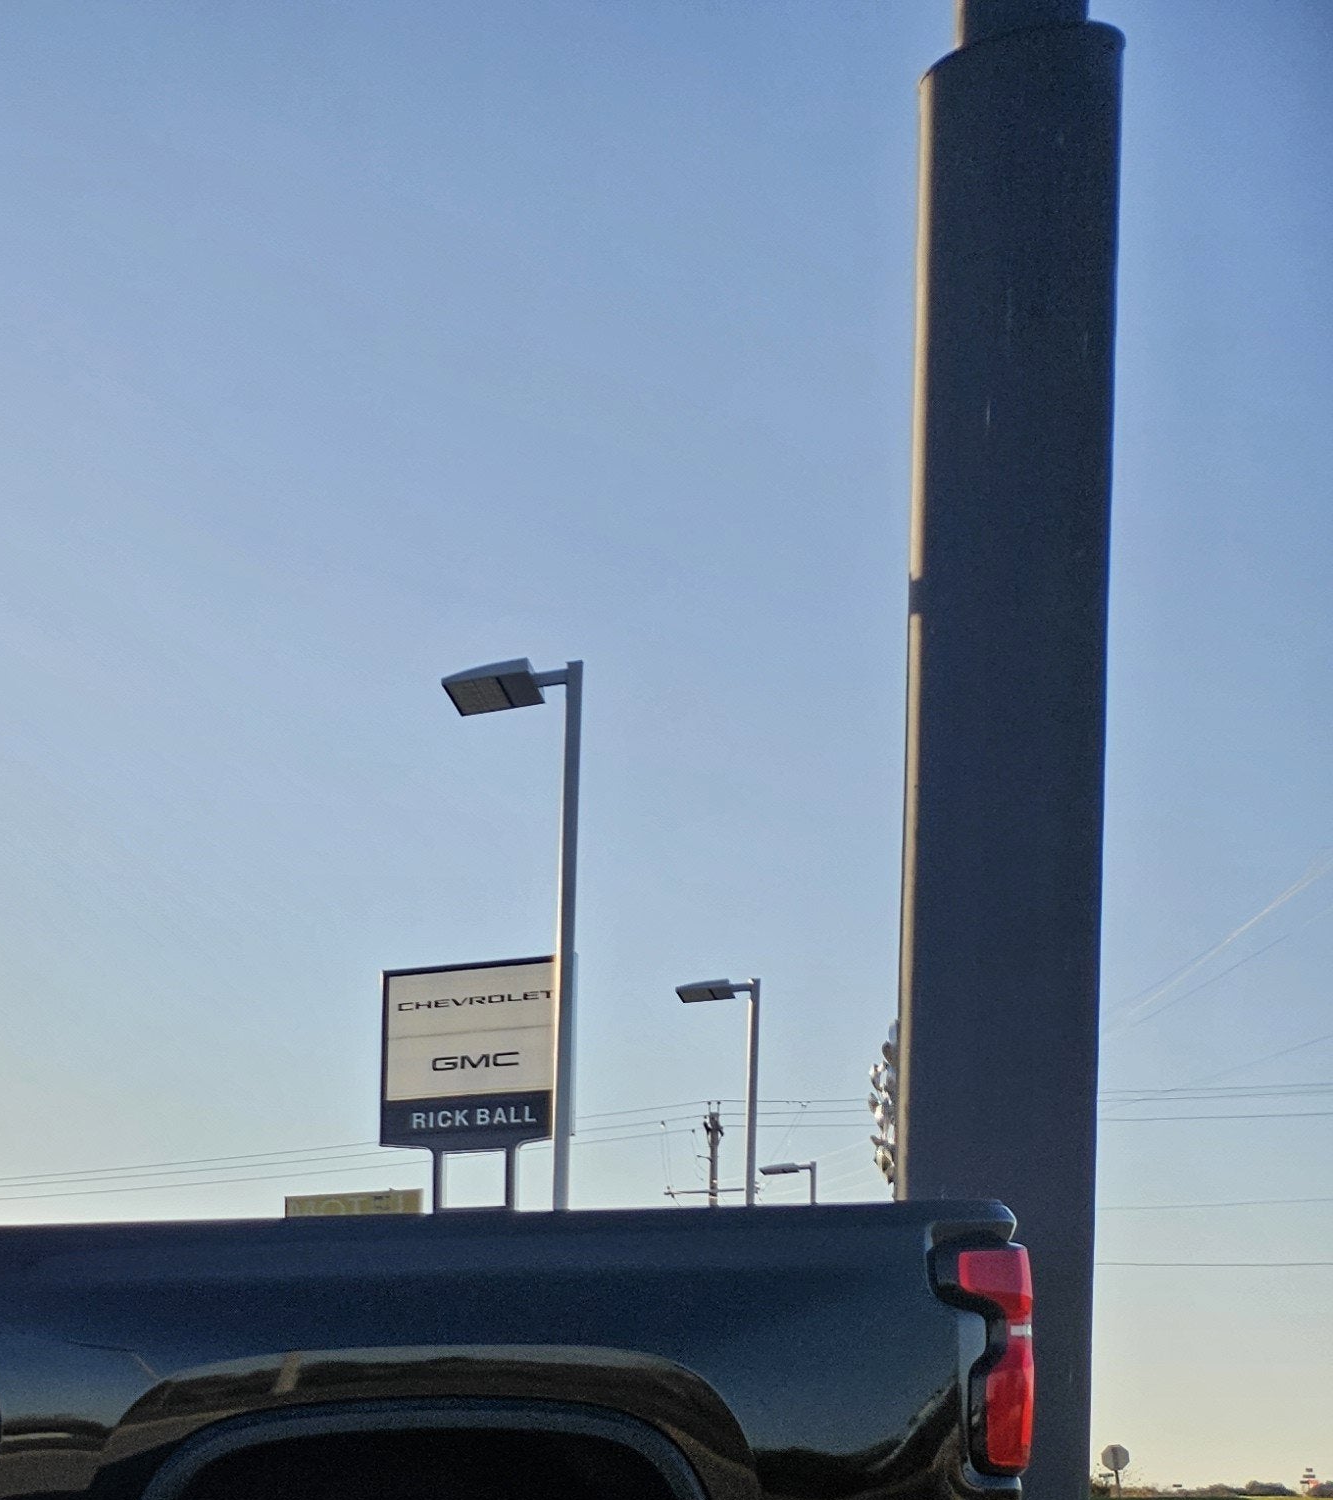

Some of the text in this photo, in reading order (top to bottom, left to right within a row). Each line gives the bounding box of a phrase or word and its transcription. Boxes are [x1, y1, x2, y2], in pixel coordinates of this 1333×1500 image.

[431, 1051, 520, 1072] GMC
[411, 1105, 537, 1129] RICK BALL
